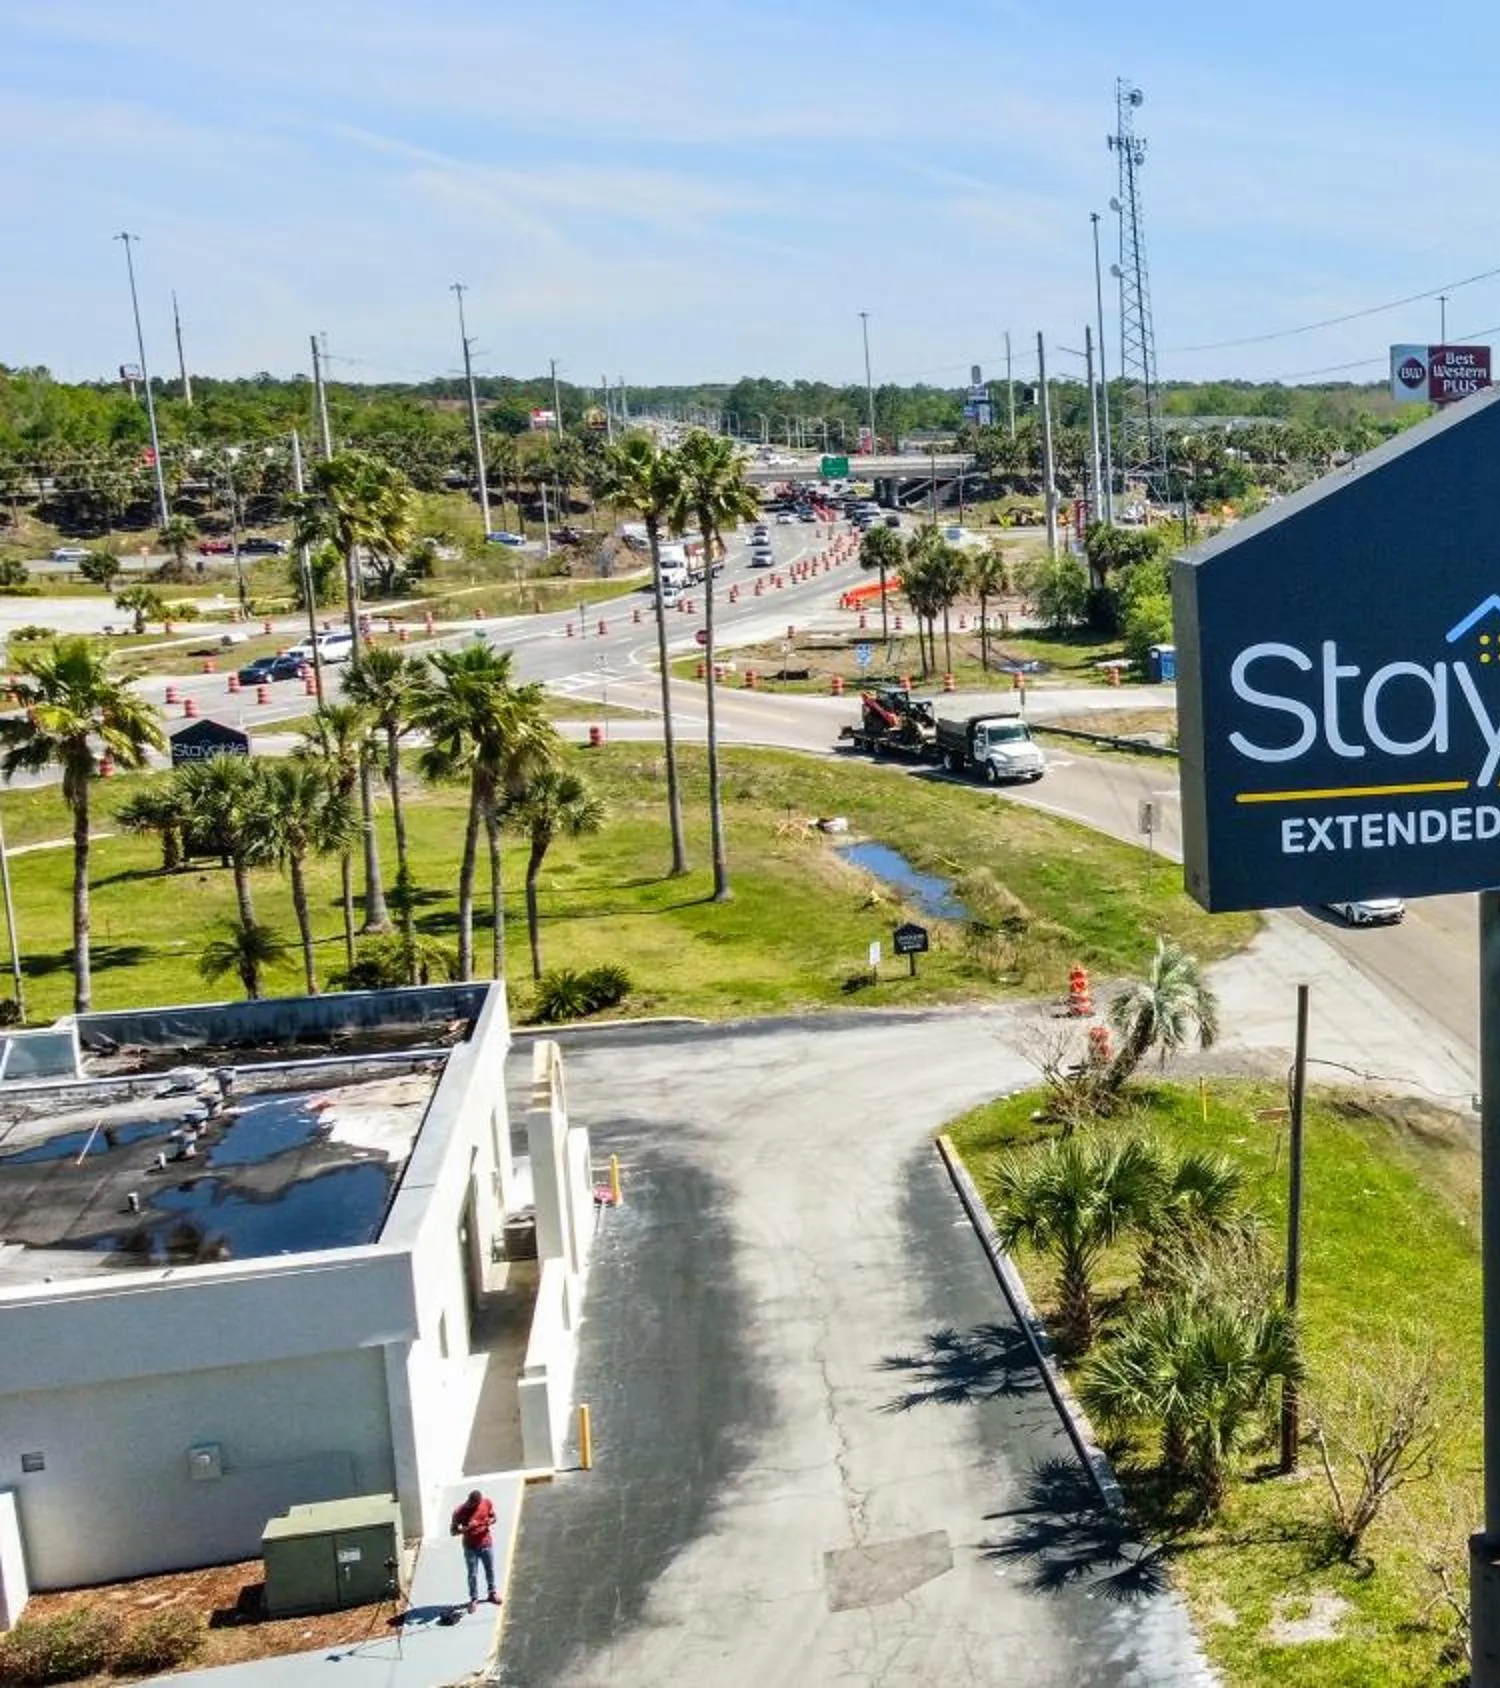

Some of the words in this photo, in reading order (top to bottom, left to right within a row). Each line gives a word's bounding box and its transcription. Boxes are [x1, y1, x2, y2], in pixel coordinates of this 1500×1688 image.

[1445, 352, 1475, 365] Best
[1433, 364, 1487, 378] Western
[1443, 379, 1477, 393] PLUS
